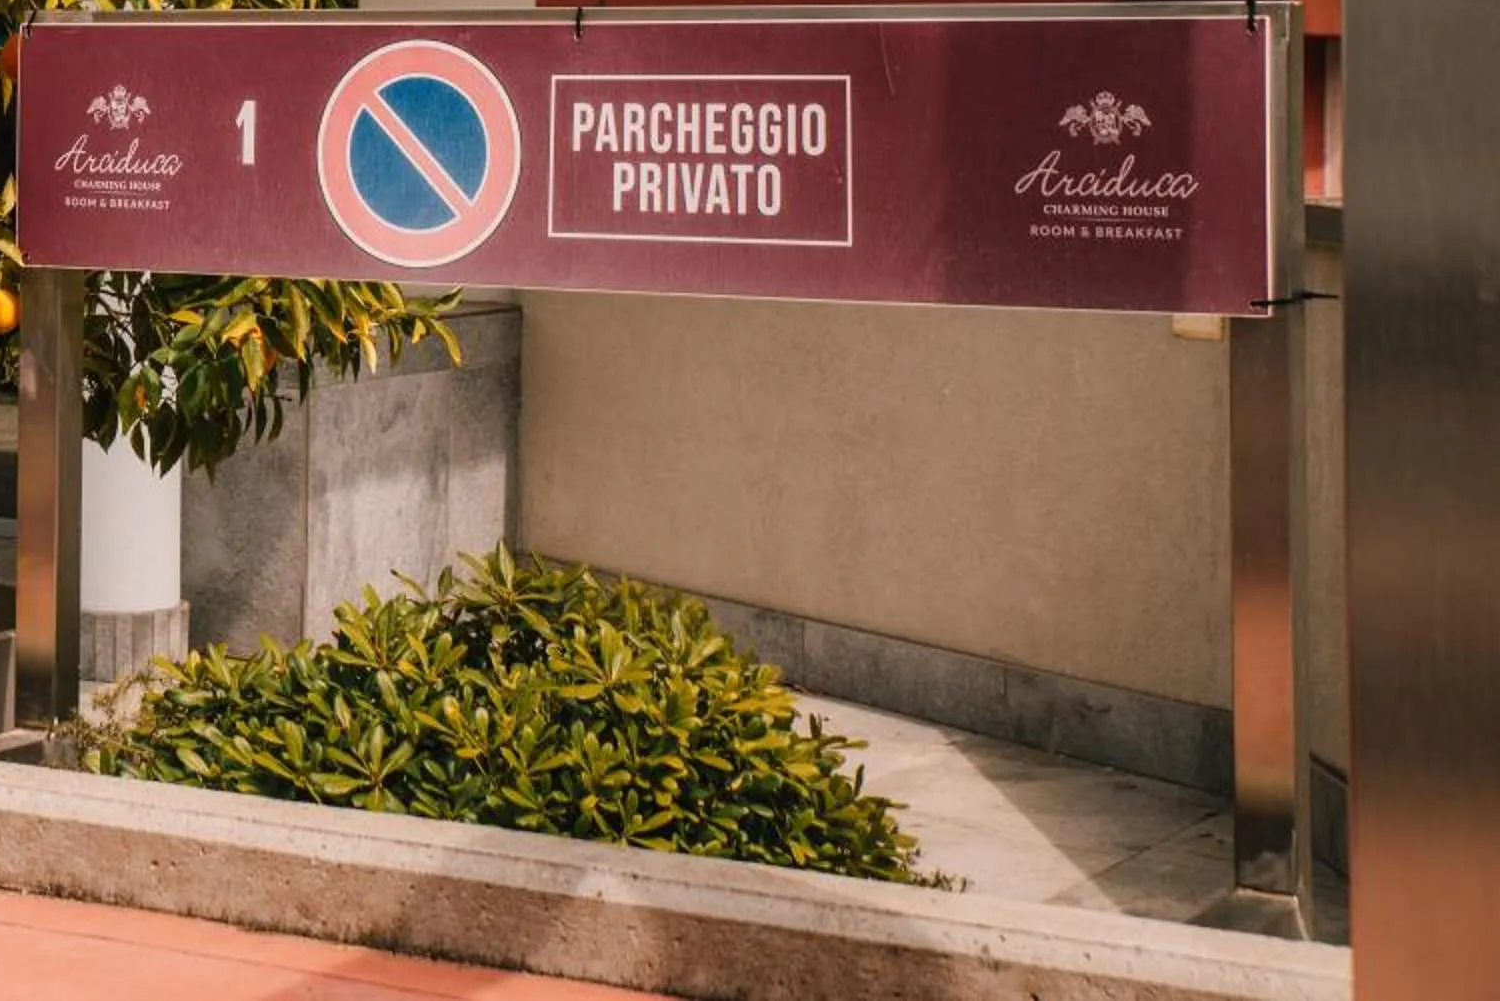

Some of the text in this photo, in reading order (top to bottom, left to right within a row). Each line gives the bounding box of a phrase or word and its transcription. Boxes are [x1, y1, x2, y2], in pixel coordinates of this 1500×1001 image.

[236, 100, 256, 165] 1
[572, 102, 827, 156] PARCHEGGIO
[54, 133, 183, 175] Arciduca
[1014, 150, 1199, 199] Arciduca
[65, 197, 170, 210] ROOM & BREAKFAST
[73, 180, 161, 191] CHARMING HOUSE
[612, 163, 781, 216] PRIVATO
[1043, 204, 1169, 217] CHARMING HOUSE
[1029, 224, 1183, 240] ROOM & BREAKFAST
